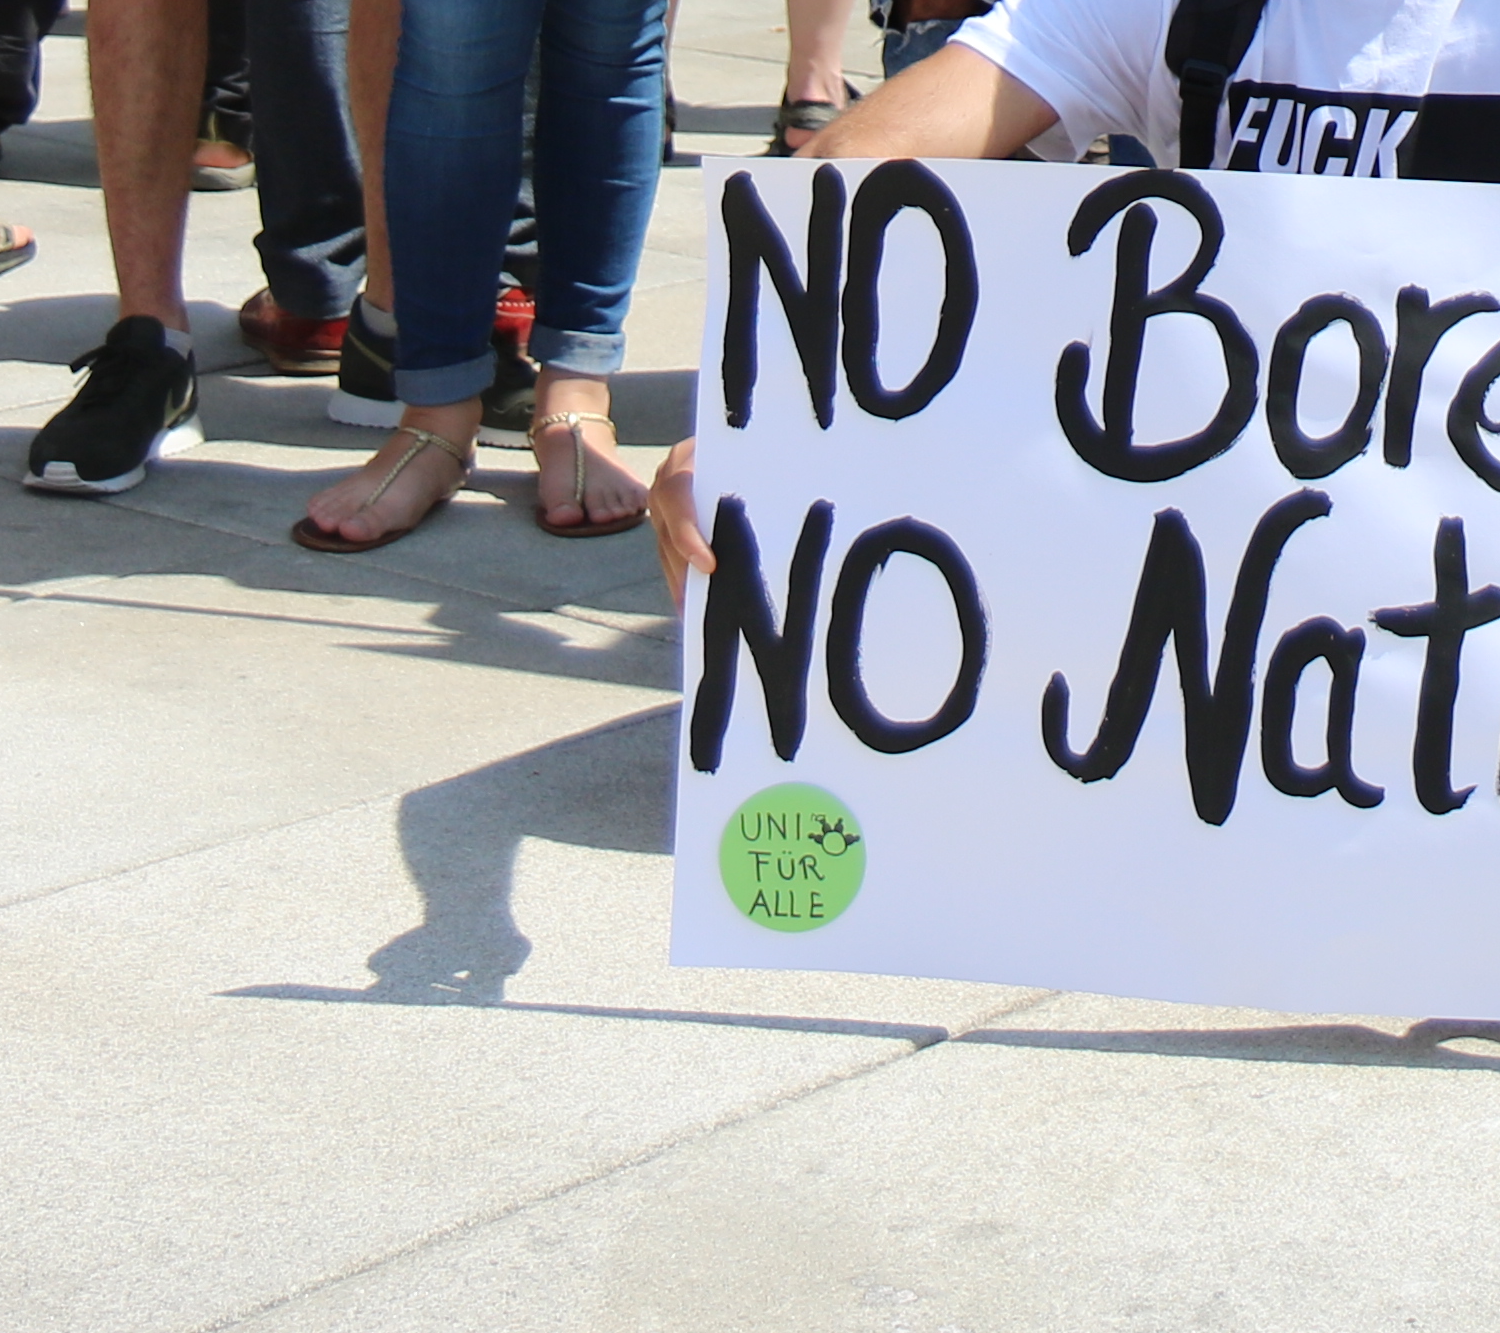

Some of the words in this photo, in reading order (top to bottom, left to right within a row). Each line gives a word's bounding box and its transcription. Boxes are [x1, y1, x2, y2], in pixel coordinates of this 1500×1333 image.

[1227, 97, 1419, 178] FUCK
[721, 158, 978, 431] NO
[691, 493, 990, 774] NO
[740, 812, 800, 841] UNI
[747, 850, 825, 882] FÜR
[749, 889, 824, 918] ALLE
